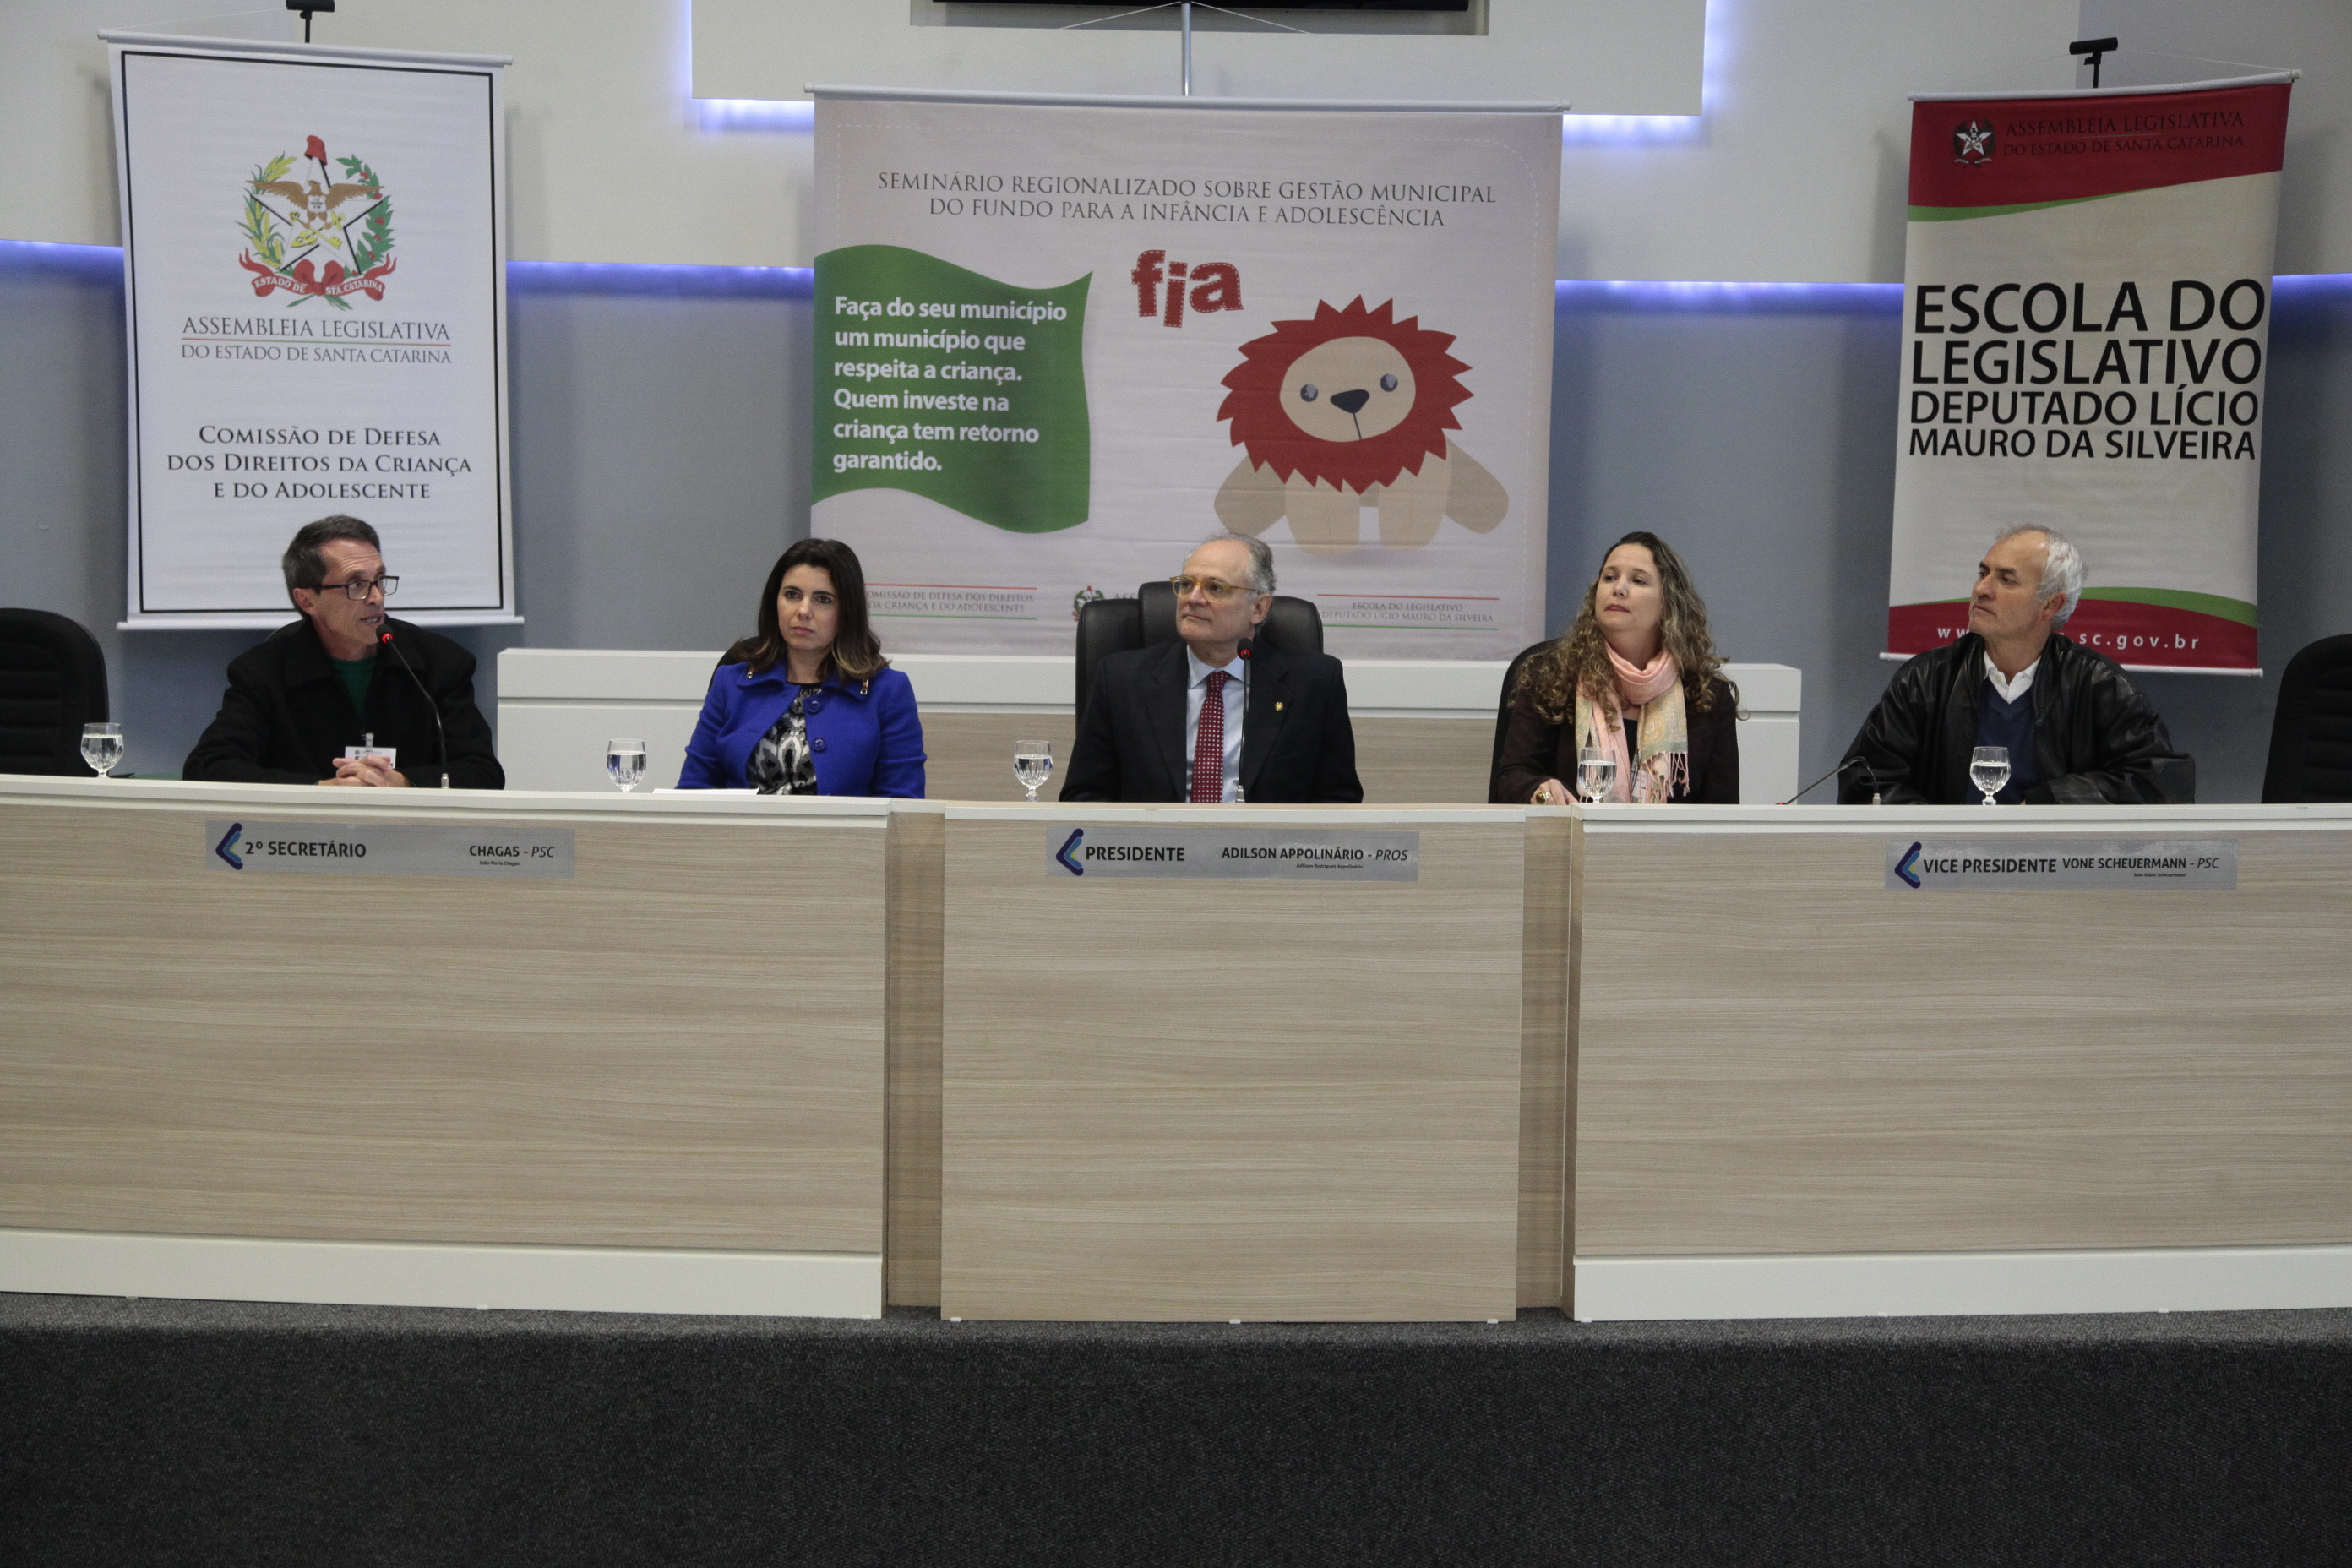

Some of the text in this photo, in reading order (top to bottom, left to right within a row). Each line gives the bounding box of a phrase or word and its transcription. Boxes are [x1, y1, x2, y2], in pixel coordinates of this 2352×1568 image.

[2006, 112, 2244, 136] ASSEMBLEIA LEGISLATIVA
[2003, 134, 2244, 156] DO ESTADO DE SANTA CATARINA
[879, 172, 1496, 203] SEMINÁRIO REGIONALIZADO SOBRE GESTÃO MUNICIPAL
[930, 198, 1444, 226] DO FUNDO PARA A INFÂNCIA E ADOLESCÊNCIA
[255, 277, 305, 294] ESTADO DE
[344, 279, 382, 292] CATARINA
[835, 296, 1067, 324] Faça do seu município
[1914, 279, 2265, 334] ESCOLA DO
[182, 317, 451, 340] ASSEMBLEIA LEGISLATIVA
[835, 329, 1026, 354] um município que
[181, 344, 451, 364] DO ESTADO DE SANTA CATARINA
[1912, 337, 2262, 385] LEGISLATIVO
[834, 359, 1022, 385] respeita a criança.
[833, 388, 1009, 411] Quem investe na
[1911, 384, 2258, 427] DEPUTADO LÍCIO
[199, 424, 441, 446] COMISSÃO DE DEFESA
[833, 420, 1039, 444] criança tem retorno
[1909, 428, 2256, 460] MAURO DA SILVEIRA
[168, 454, 471, 477] DOS DIREITOS DA CRIANÇA
[833, 450, 942, 473] garantido.
[214, 481, 430, 499] E DO ADOLESCENTE
[865, 590, 911, 600] OMISSÃO
[929, 592, 964, 602] DEFESA
[966, 593, 986, 602] DOS
[988, 593, 1033, 602] DIREITOS
[868, 601, 881, 609] DA
[884, 601, 928, 611] CRIANÇA
[939, 602, 955, 611] DO
[957, 602, 1025, 612] ADOLESCENTE
[1352, 602, 1463, 612] ESCOLA DO LEGISLATIVO
[1322, 609, 1493, 623] DEPUTADO LÍCIO MAURO DA SILVEIRA
[268, 840, 367, 858] SECRETÁRIO
[469, 844, 520, 858] CHAGAS
[531, 846, 555, 858] PSC
[1086, 846, 1185, 862] PRESIDENTE
[1222, 847, 1277, 859] ADILSON
[1279, 847, 1364, 860] APPOLINÁRIO
[1375, 850, 1408, 862] PROS
[1923, 858, 2057, 873] VICE PRESIDENTE
[2062, 858, 2095, 869] VONE
[2098, 858, 2186, 869] SCHEUERMANN
[2197, 858, 2220, 869] PSC
